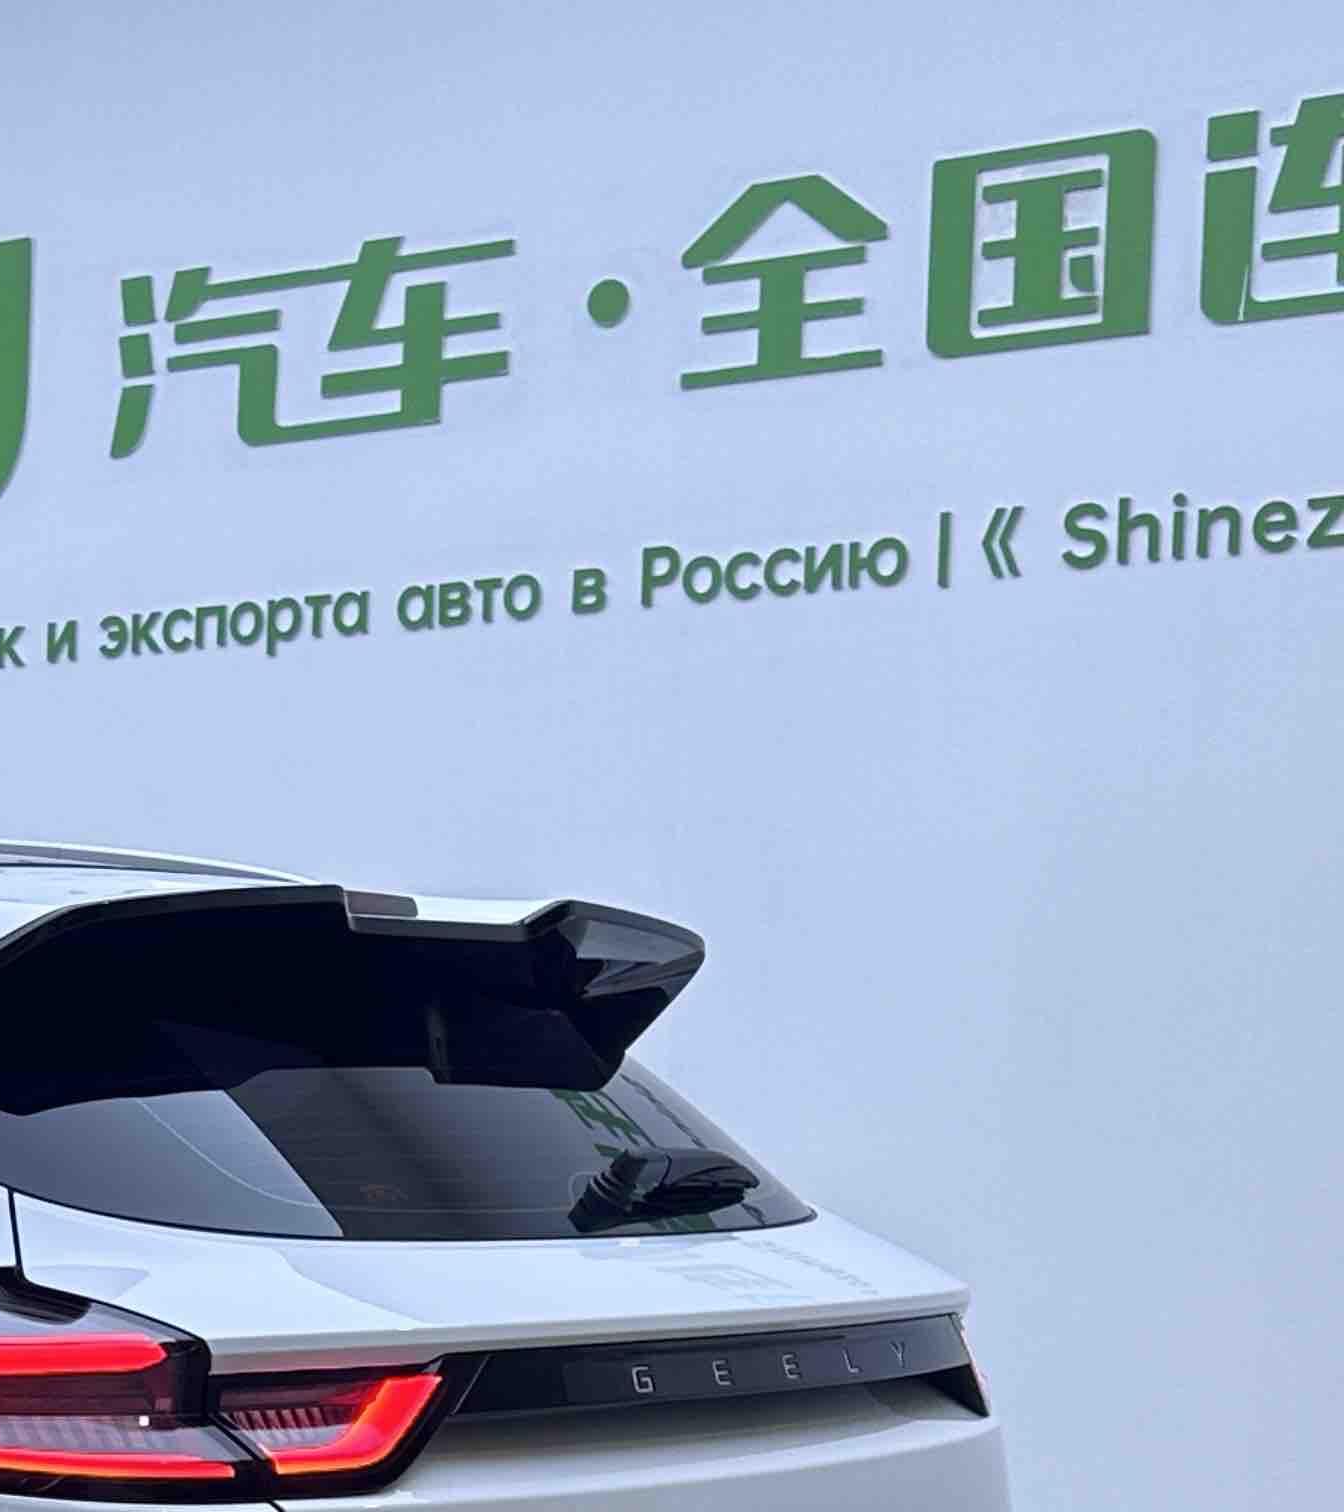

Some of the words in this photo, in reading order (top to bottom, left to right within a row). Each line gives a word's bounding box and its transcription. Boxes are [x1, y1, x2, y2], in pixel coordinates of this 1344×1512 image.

[47, 618, 79, 661] и
[99, 584, 370, 656] экспорта
[397, 573, 542, 632] авто
[571, 566, 608, 614] в
[640, 536, 909, 608] Россию
[632, 1342, 907, 1394] GEELY
